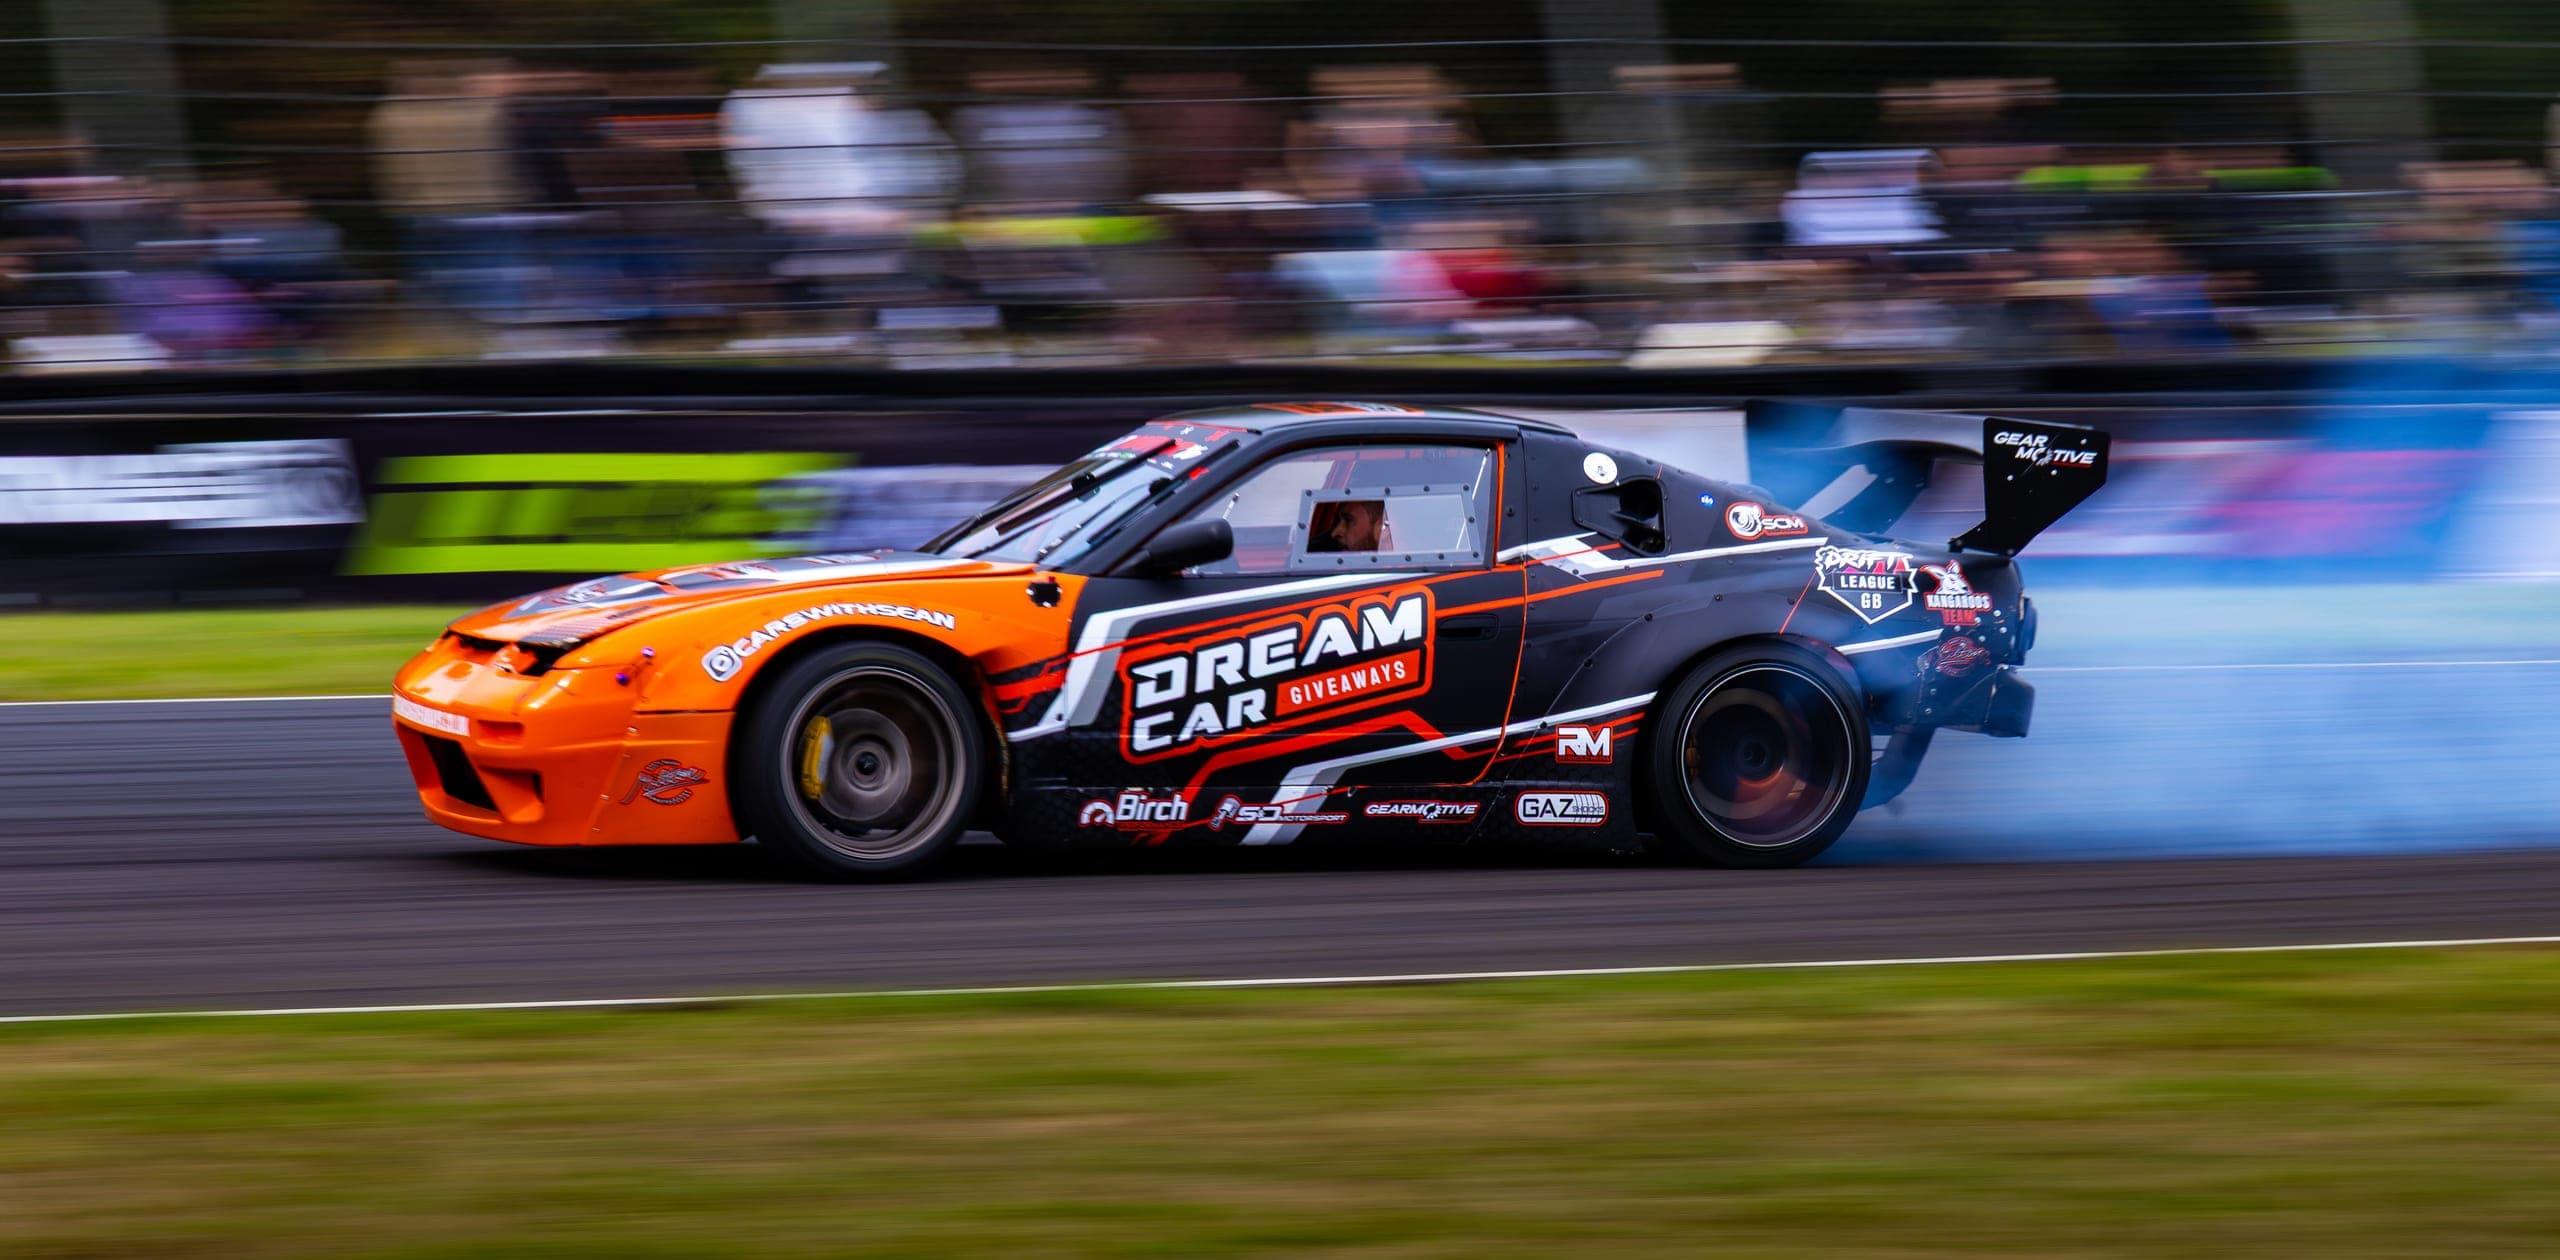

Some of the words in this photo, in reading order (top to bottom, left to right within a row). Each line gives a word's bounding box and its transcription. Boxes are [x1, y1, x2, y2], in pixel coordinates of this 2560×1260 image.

[1993, 431, 2049, 447] GEAR
[2015, 446, 2098, 466] MOTIVE
[1761, 517, 1804, 530] SCM
[1823, 549, 1914, 572] DRIFT
[1840, 575, 1896, 590] LEAGUE
[1860, 592, 1883, 609] GB
[1926, 593, 1991, 610] KANGAROOS
[1942, 609, 1977, 624] TEAM
[732, 602, 956, 659] CARSWITHSEAN
[1131, 596, 1423, 709] DREAM
[1289, 660, 1407, 706] GIVEAWAYS
[1132, 687, 1267, 752] CAR
[1558, 727, 1611, 756] RM
[1115, 793, 1188, 821] Birch
[1365, 802, 1478, 819] GEARMOTIVE
[1522, 798, 1576, 818] GAZ
